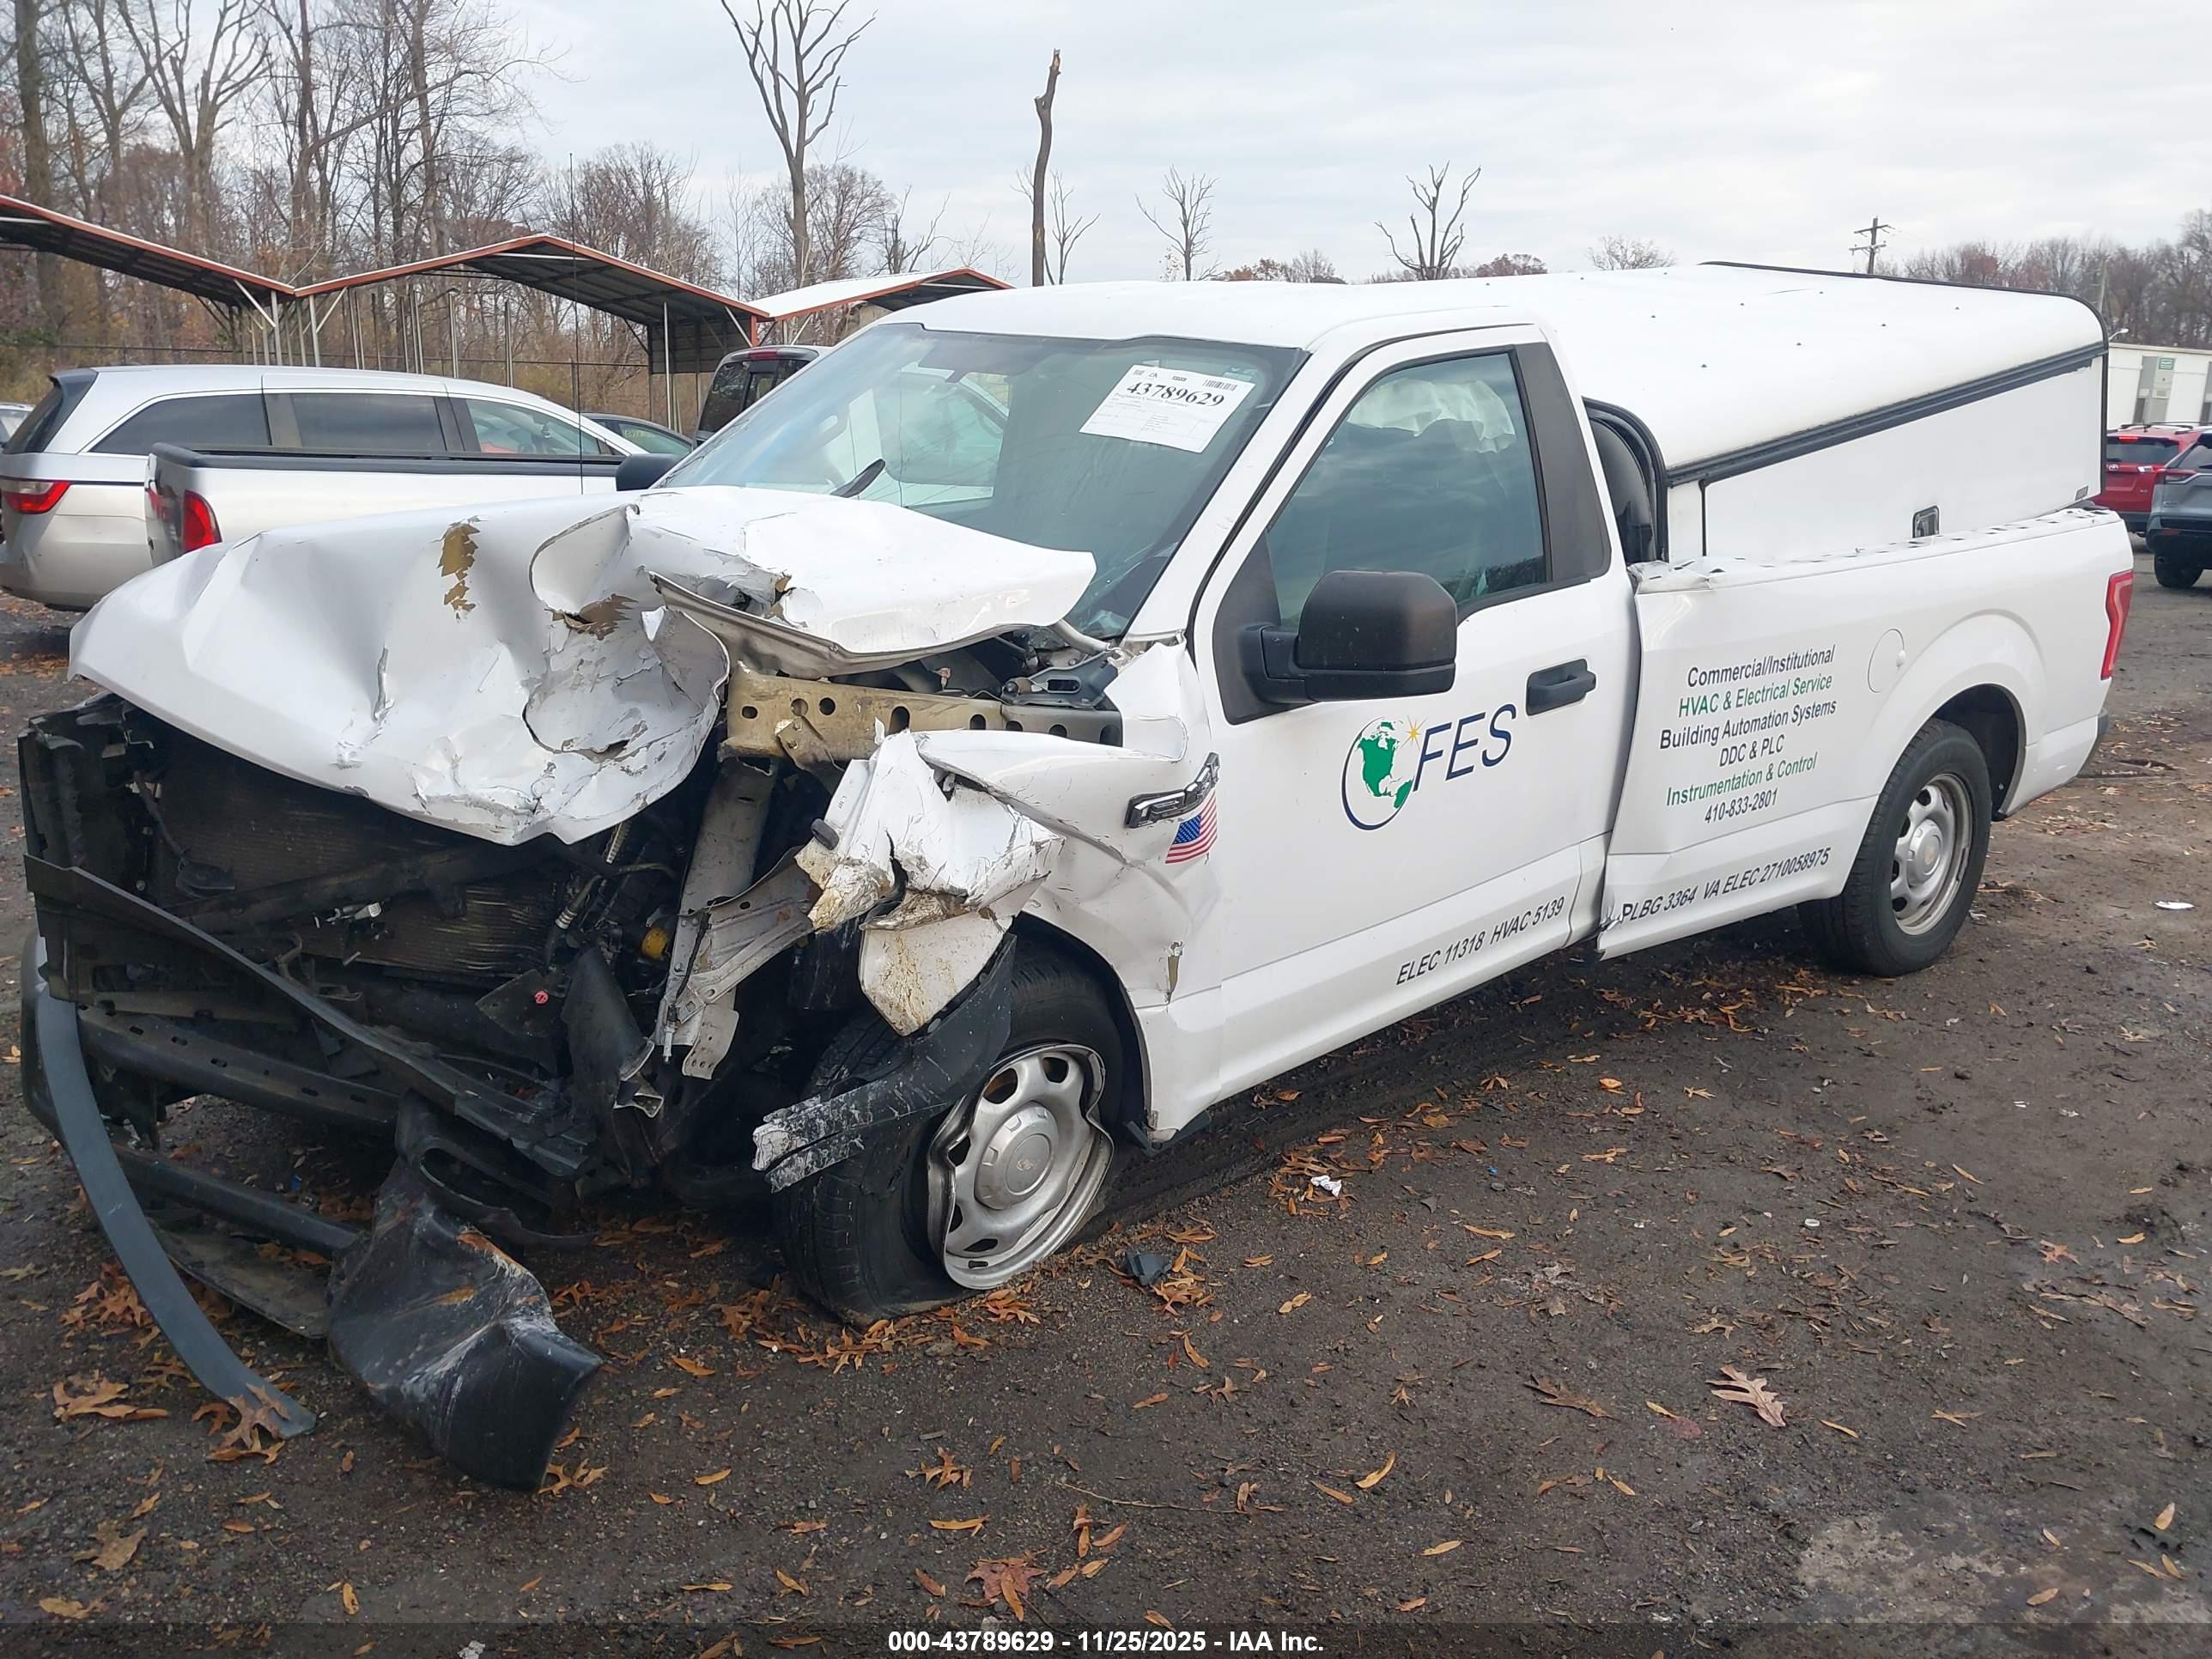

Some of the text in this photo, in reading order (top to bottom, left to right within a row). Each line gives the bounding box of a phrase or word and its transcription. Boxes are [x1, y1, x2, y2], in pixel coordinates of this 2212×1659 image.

[1126, 381, 1225, 407] 43789629
[1687, 644, 1836, 687] Commercial/Institutional
[1678, 672, 1832, 718] HVAC & Electrical Service
[1413, 703, 1516, 793] FES
[1660, 699, 1837, 750] Building Automation Systems
[1719, 734, 1785, 767] DDC & PLC
[1666, 751, 1818, 806] Instrumentation & Control
[1704, 787, 1778, 824] 410-833-2801
[1620, 847, 1832, 924] PLBG 3364 VA ELEC 2710058975
[1395, 896, 1565, 985] ELEC 11318 HVAC 5139
